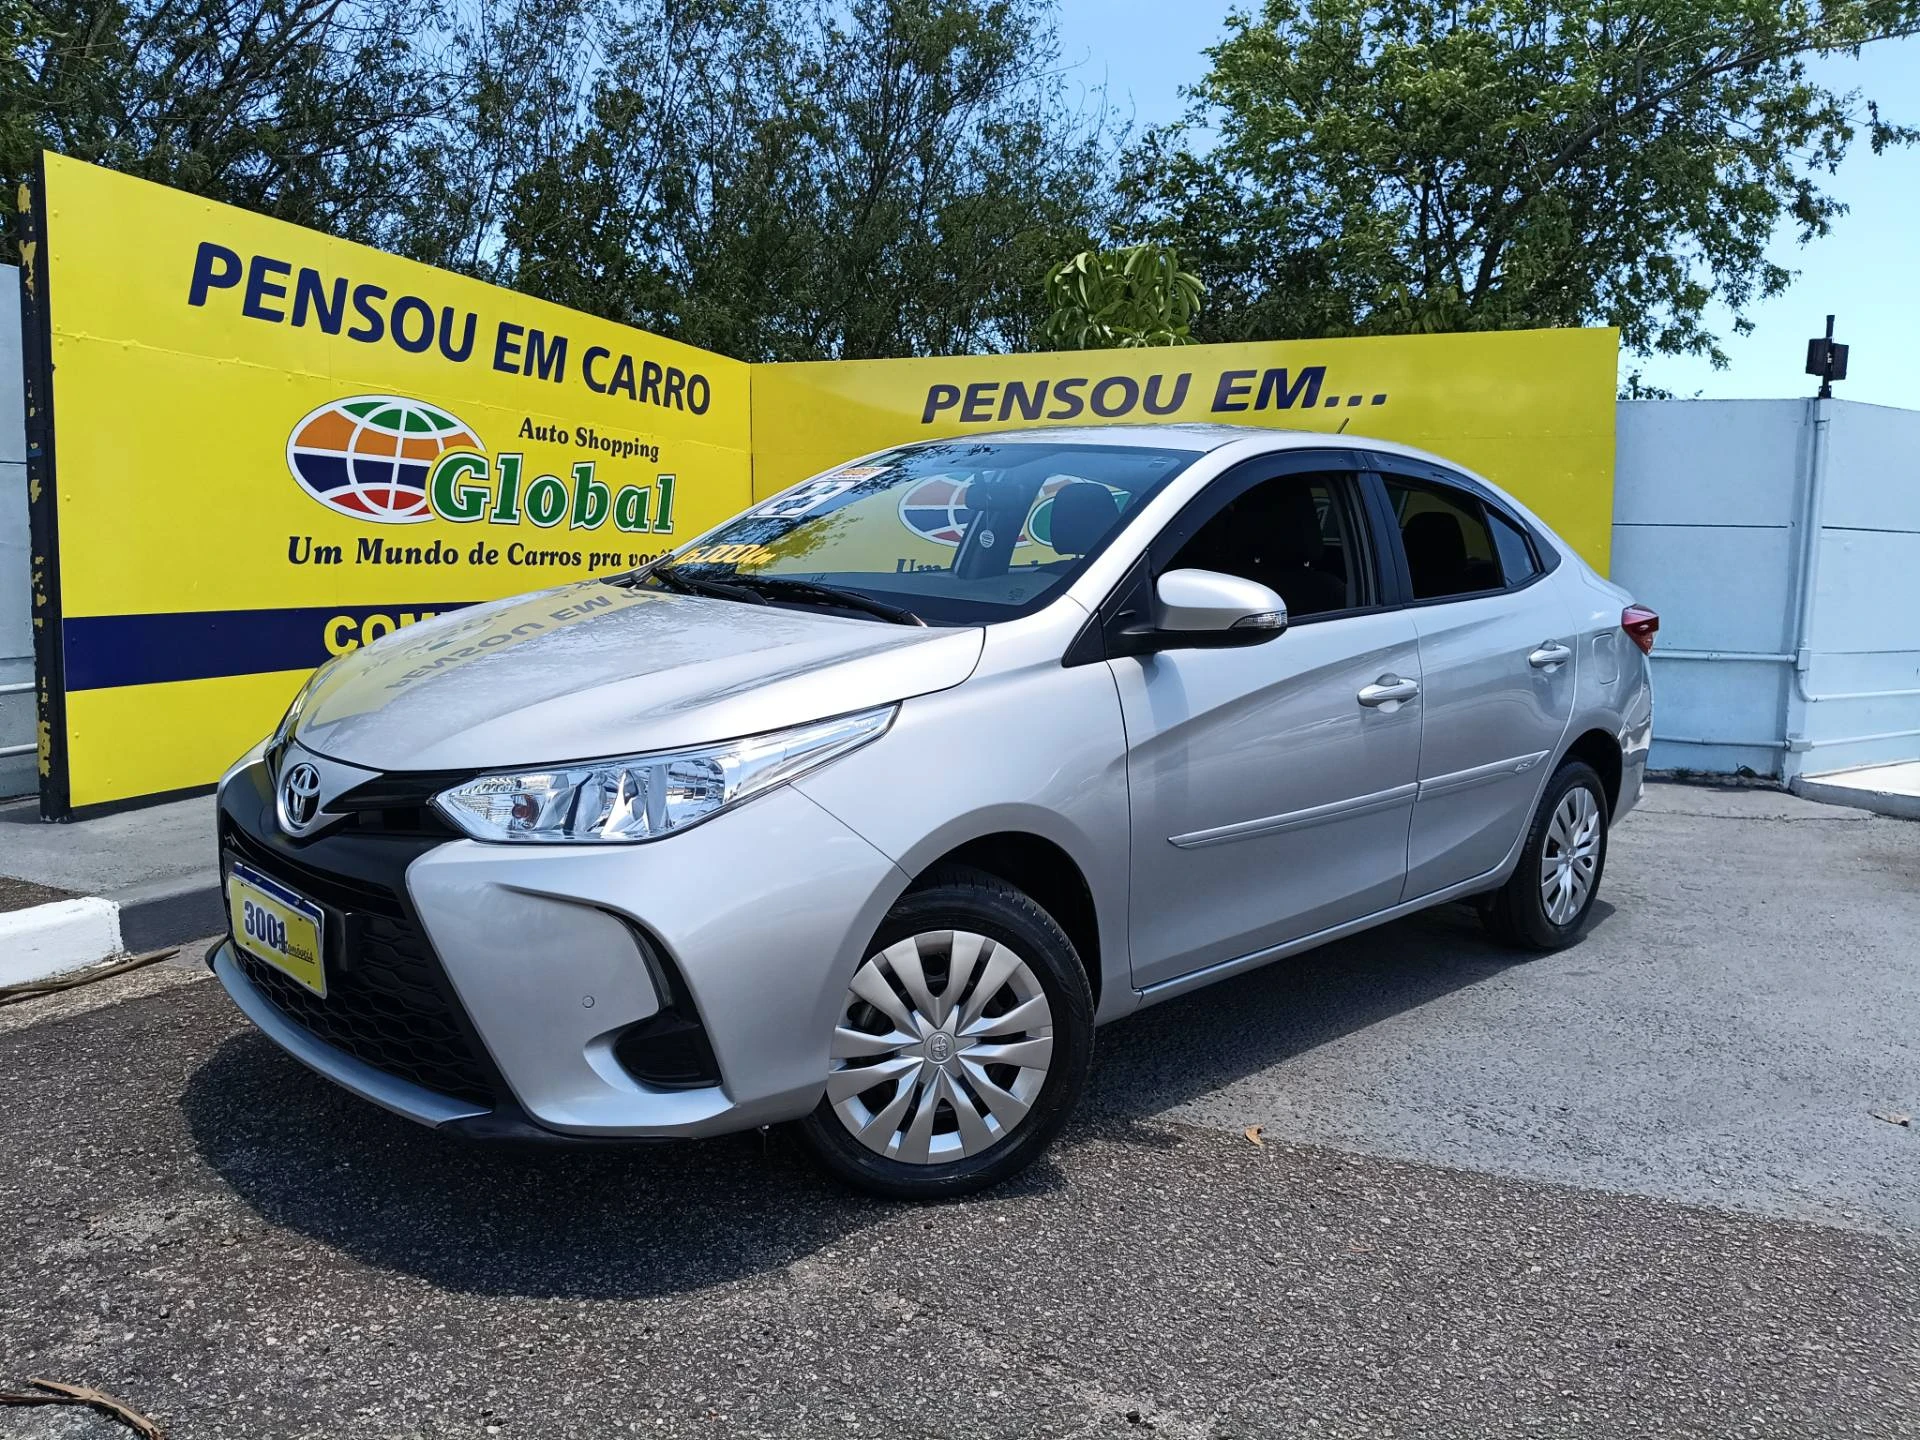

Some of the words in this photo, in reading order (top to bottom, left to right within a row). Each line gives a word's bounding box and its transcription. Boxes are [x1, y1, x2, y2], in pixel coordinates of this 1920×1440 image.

[188, 242, 478, 363] PENSOU
[493, 321, 569, 383] EM
[582, 346, 711, 415] CARRO
[921, 373, 1192, 424] PENSOU
[1211, 366, 1387, 413] EM...
[518, 417, 569, 445] Auto
[574, 427, 660, 462] Shopping
[429, 451, 677, 535] Global
[287, 536, 343, 565] Um
[355, 537, 459, 565] Mundo
[468, 542, 499, 566] de
[507, 543, 582, 567] Carros
[588, 553, 622, 571] pra
[244, 900, 288, 955] 3001
